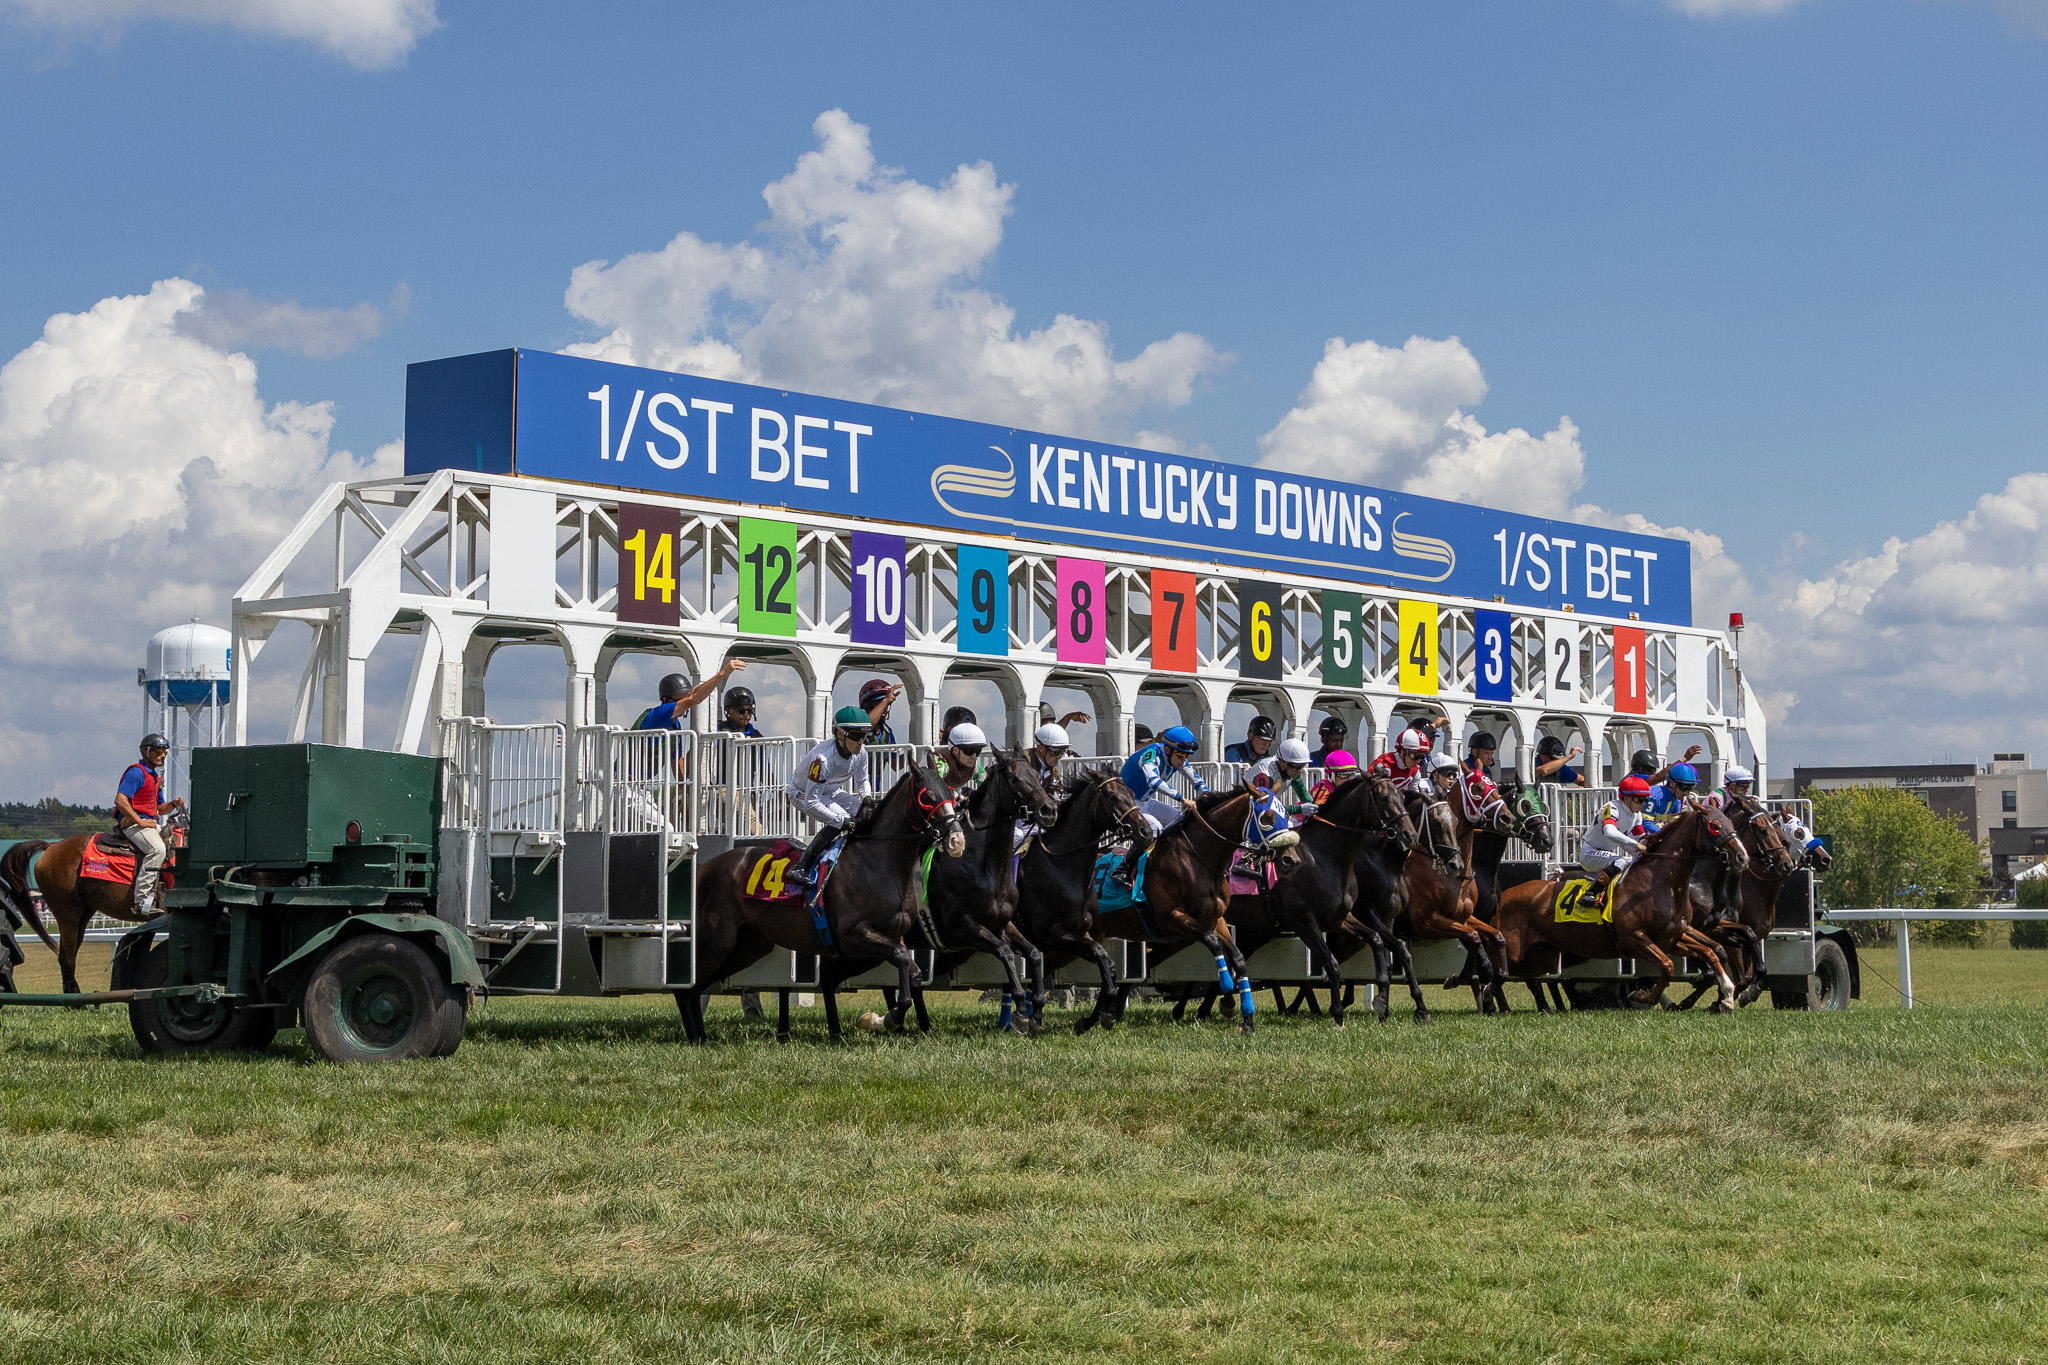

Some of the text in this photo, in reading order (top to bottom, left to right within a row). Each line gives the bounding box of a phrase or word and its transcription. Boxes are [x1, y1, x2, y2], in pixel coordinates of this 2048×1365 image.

[588, 384, 873, 493] 1/ST BET
[1029, 443, 1383, 551] KENTUCKY DOWNS
[624, 528, 676, 604] 14
[744, 542, 792, 615] 12
[856, 554, 902, 626] 10
[1493, 528, 1658, 606] 1/ST BET
[971, 568, 995, 634] 9
[1070, 580, 1093, 644] 8
[1163, 590, 1185, 651] 7
[1251, 600, 1272, 662] 6
[1332, 609, 1353, 669] 5
[1409, 621, 1429, 677] 4
[1484, 628, 1503, 685] 3
[1554, 637, 1571, 691] 2
[1623, 645, 1637, 698] 1
[809, 762, 820, 779] 14
[1144, 750, 1153, 761] 9
[1940, 775, 1965, 783] SUITES
[1602, 807, 1609, 817] 4
[1645, 801, 1654, 812] 3
[746, 853, 791, 898] 14
[1560, 884, 1584, 916] 4
